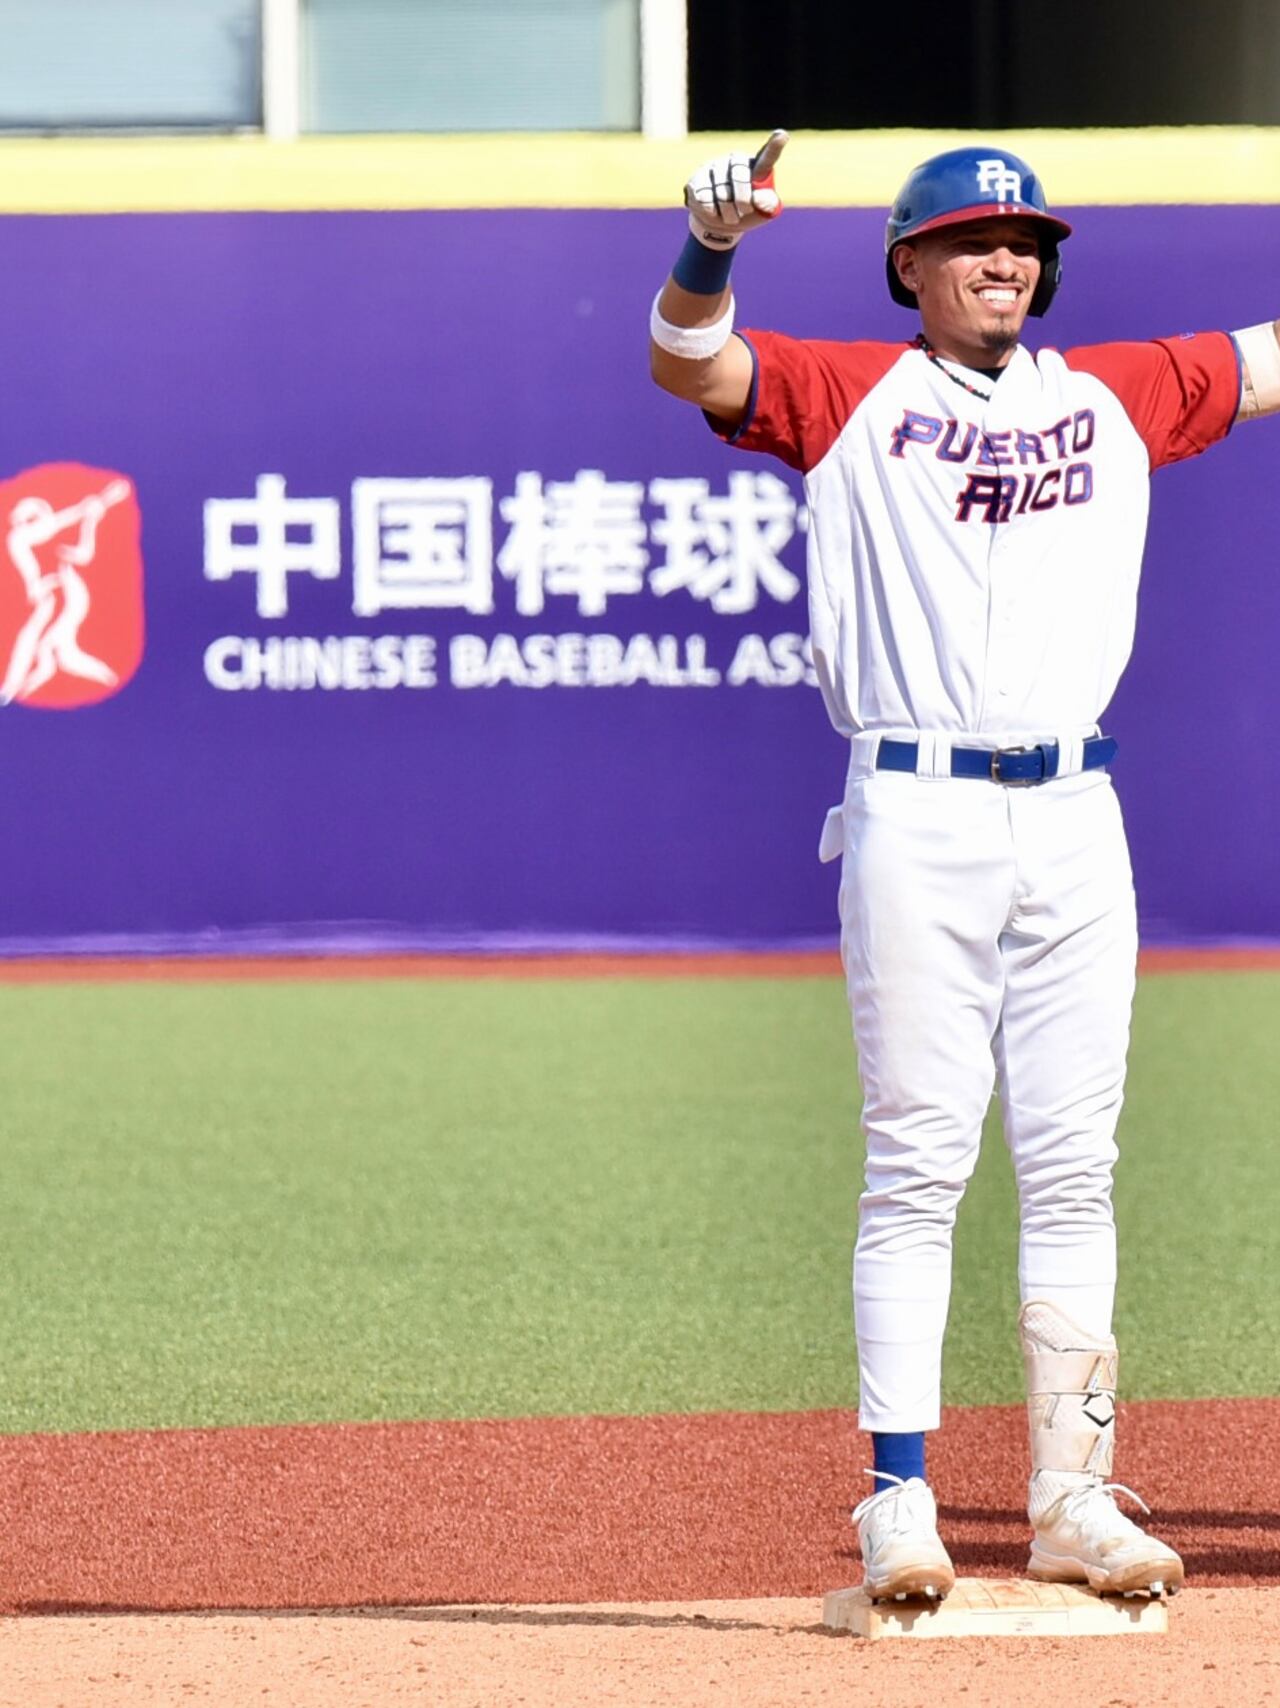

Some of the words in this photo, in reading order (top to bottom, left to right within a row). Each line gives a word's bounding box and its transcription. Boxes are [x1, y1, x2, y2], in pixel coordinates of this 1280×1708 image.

[888, 408, 1095, 466] PUERTO
[954, 461, 1093, 523] RICO
[203, 468, 809, 618] 中国棒球
[203, 635, 438, 691] CHINESE
[449, 632, 721, 689] BASEBALL
